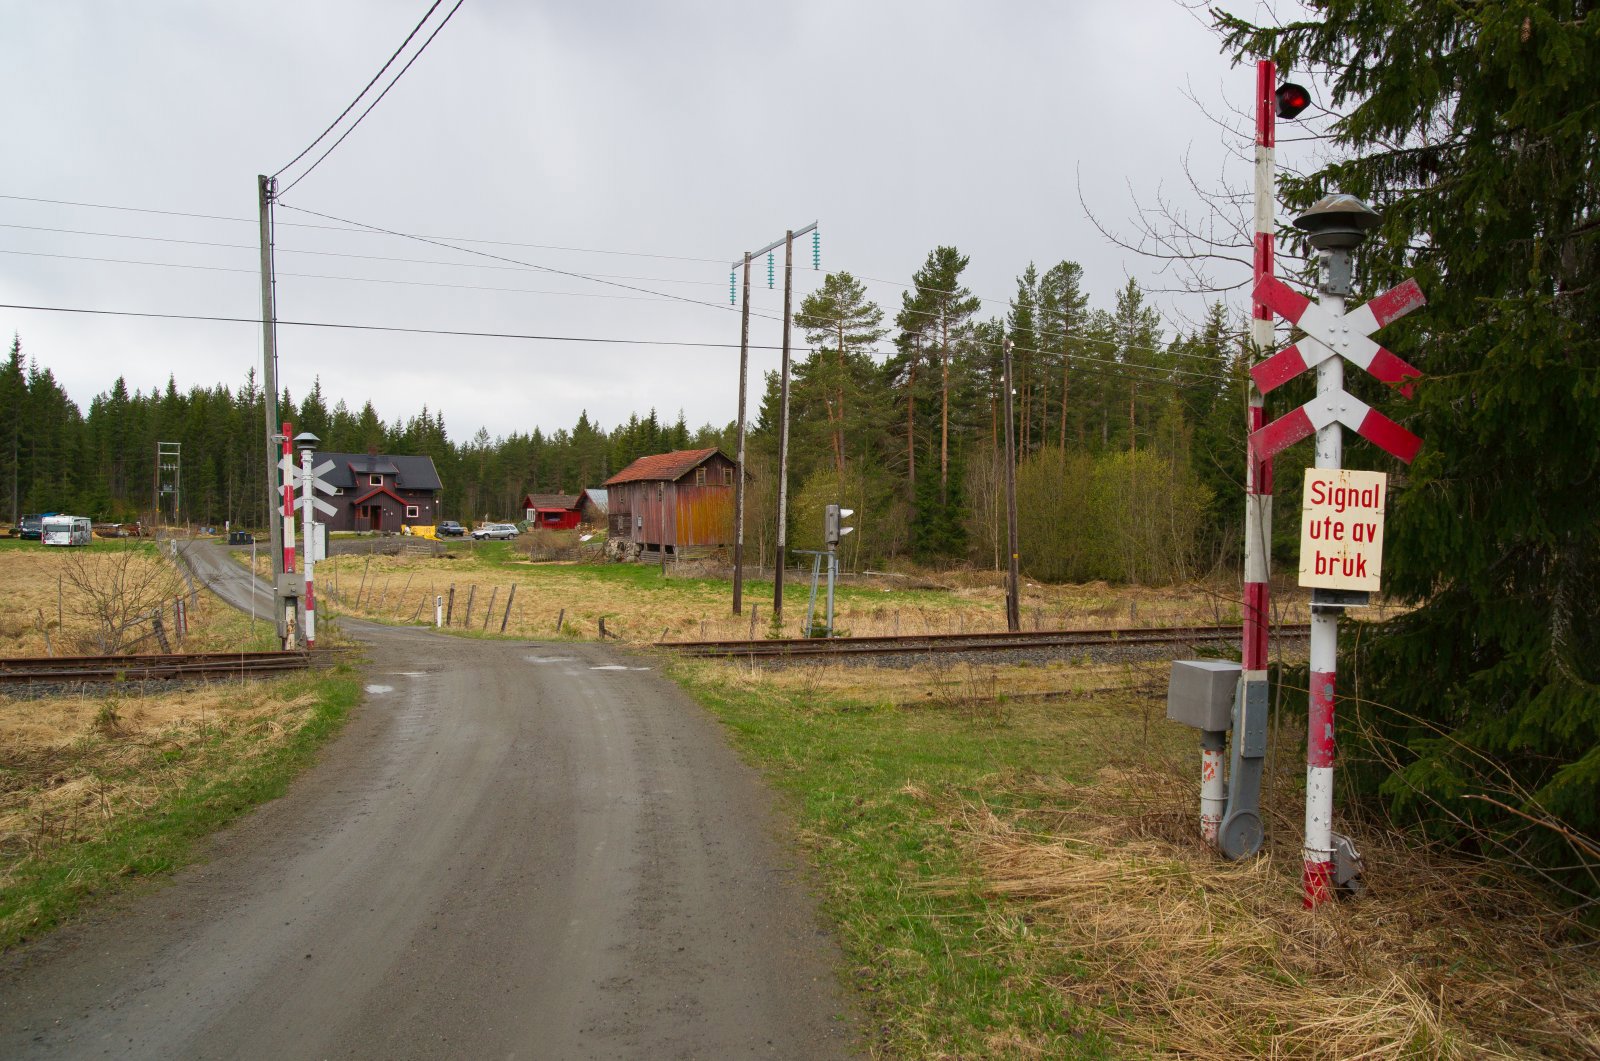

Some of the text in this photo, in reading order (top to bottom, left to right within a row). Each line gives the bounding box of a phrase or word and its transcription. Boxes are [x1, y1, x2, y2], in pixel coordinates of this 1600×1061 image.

[1311, 480, 1380, 513] Signal
[1310, 516, 1377, 543] ute av
[1315, 550, 1367, 578] bruk
